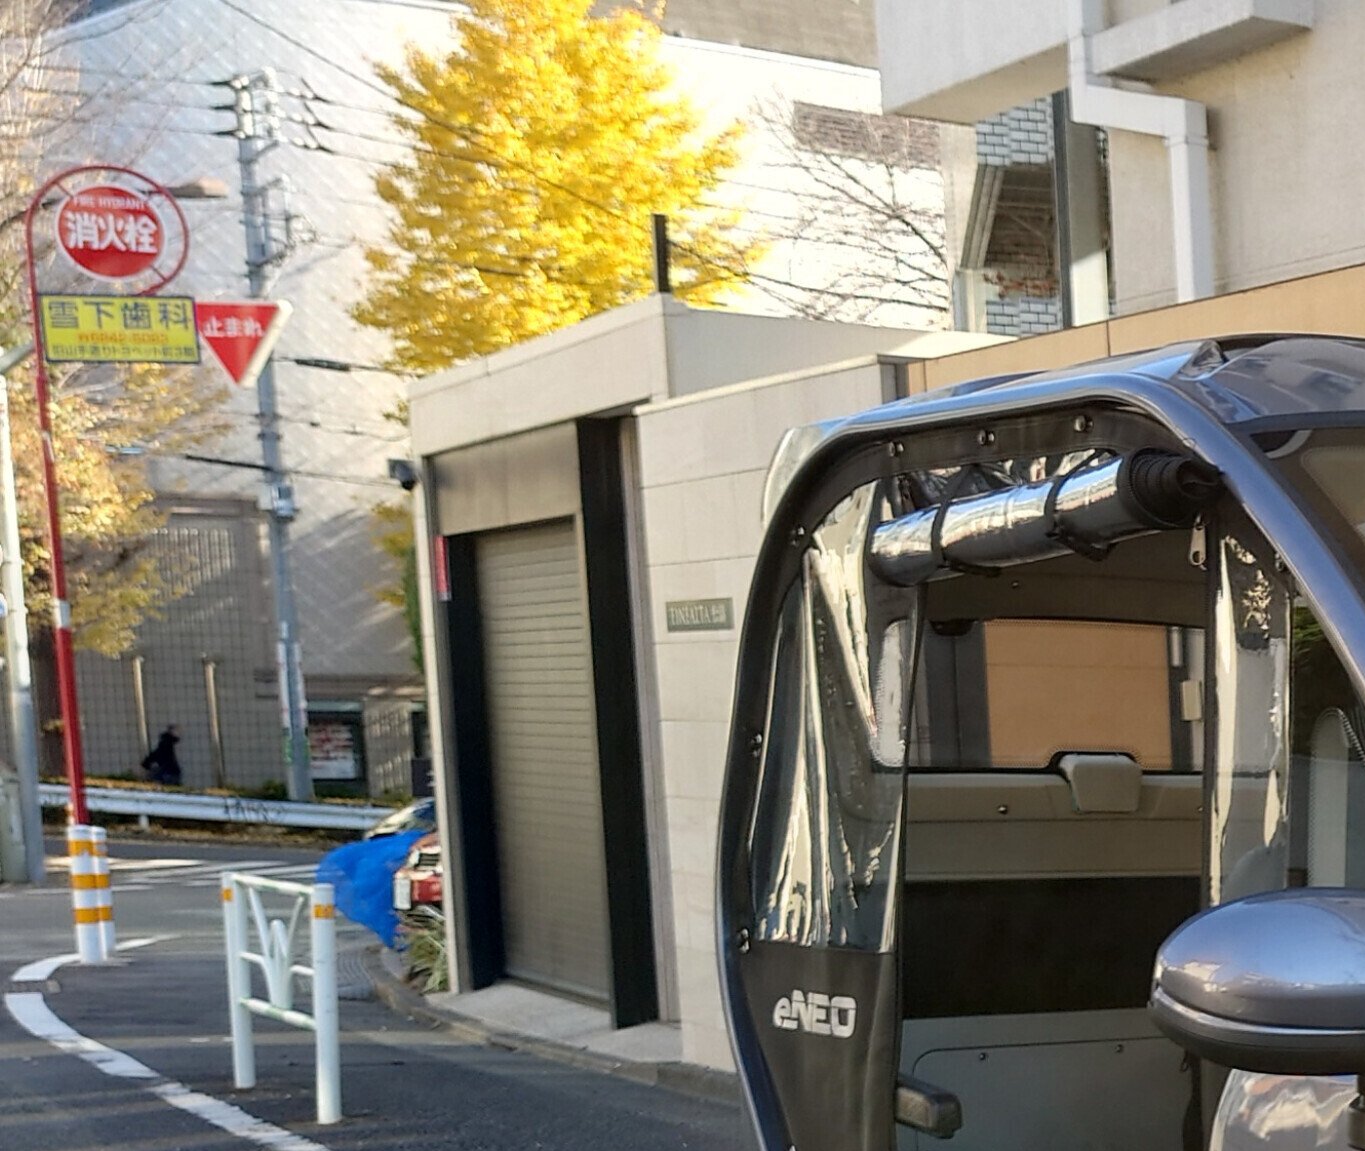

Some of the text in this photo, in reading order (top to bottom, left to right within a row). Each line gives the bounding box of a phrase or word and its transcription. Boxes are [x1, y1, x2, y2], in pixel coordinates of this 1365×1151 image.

[64, 210, 158, 254] 消火栓
[202, 314, 264, 338] 止まれ
[772, 989, 857, 1039] eNEO
